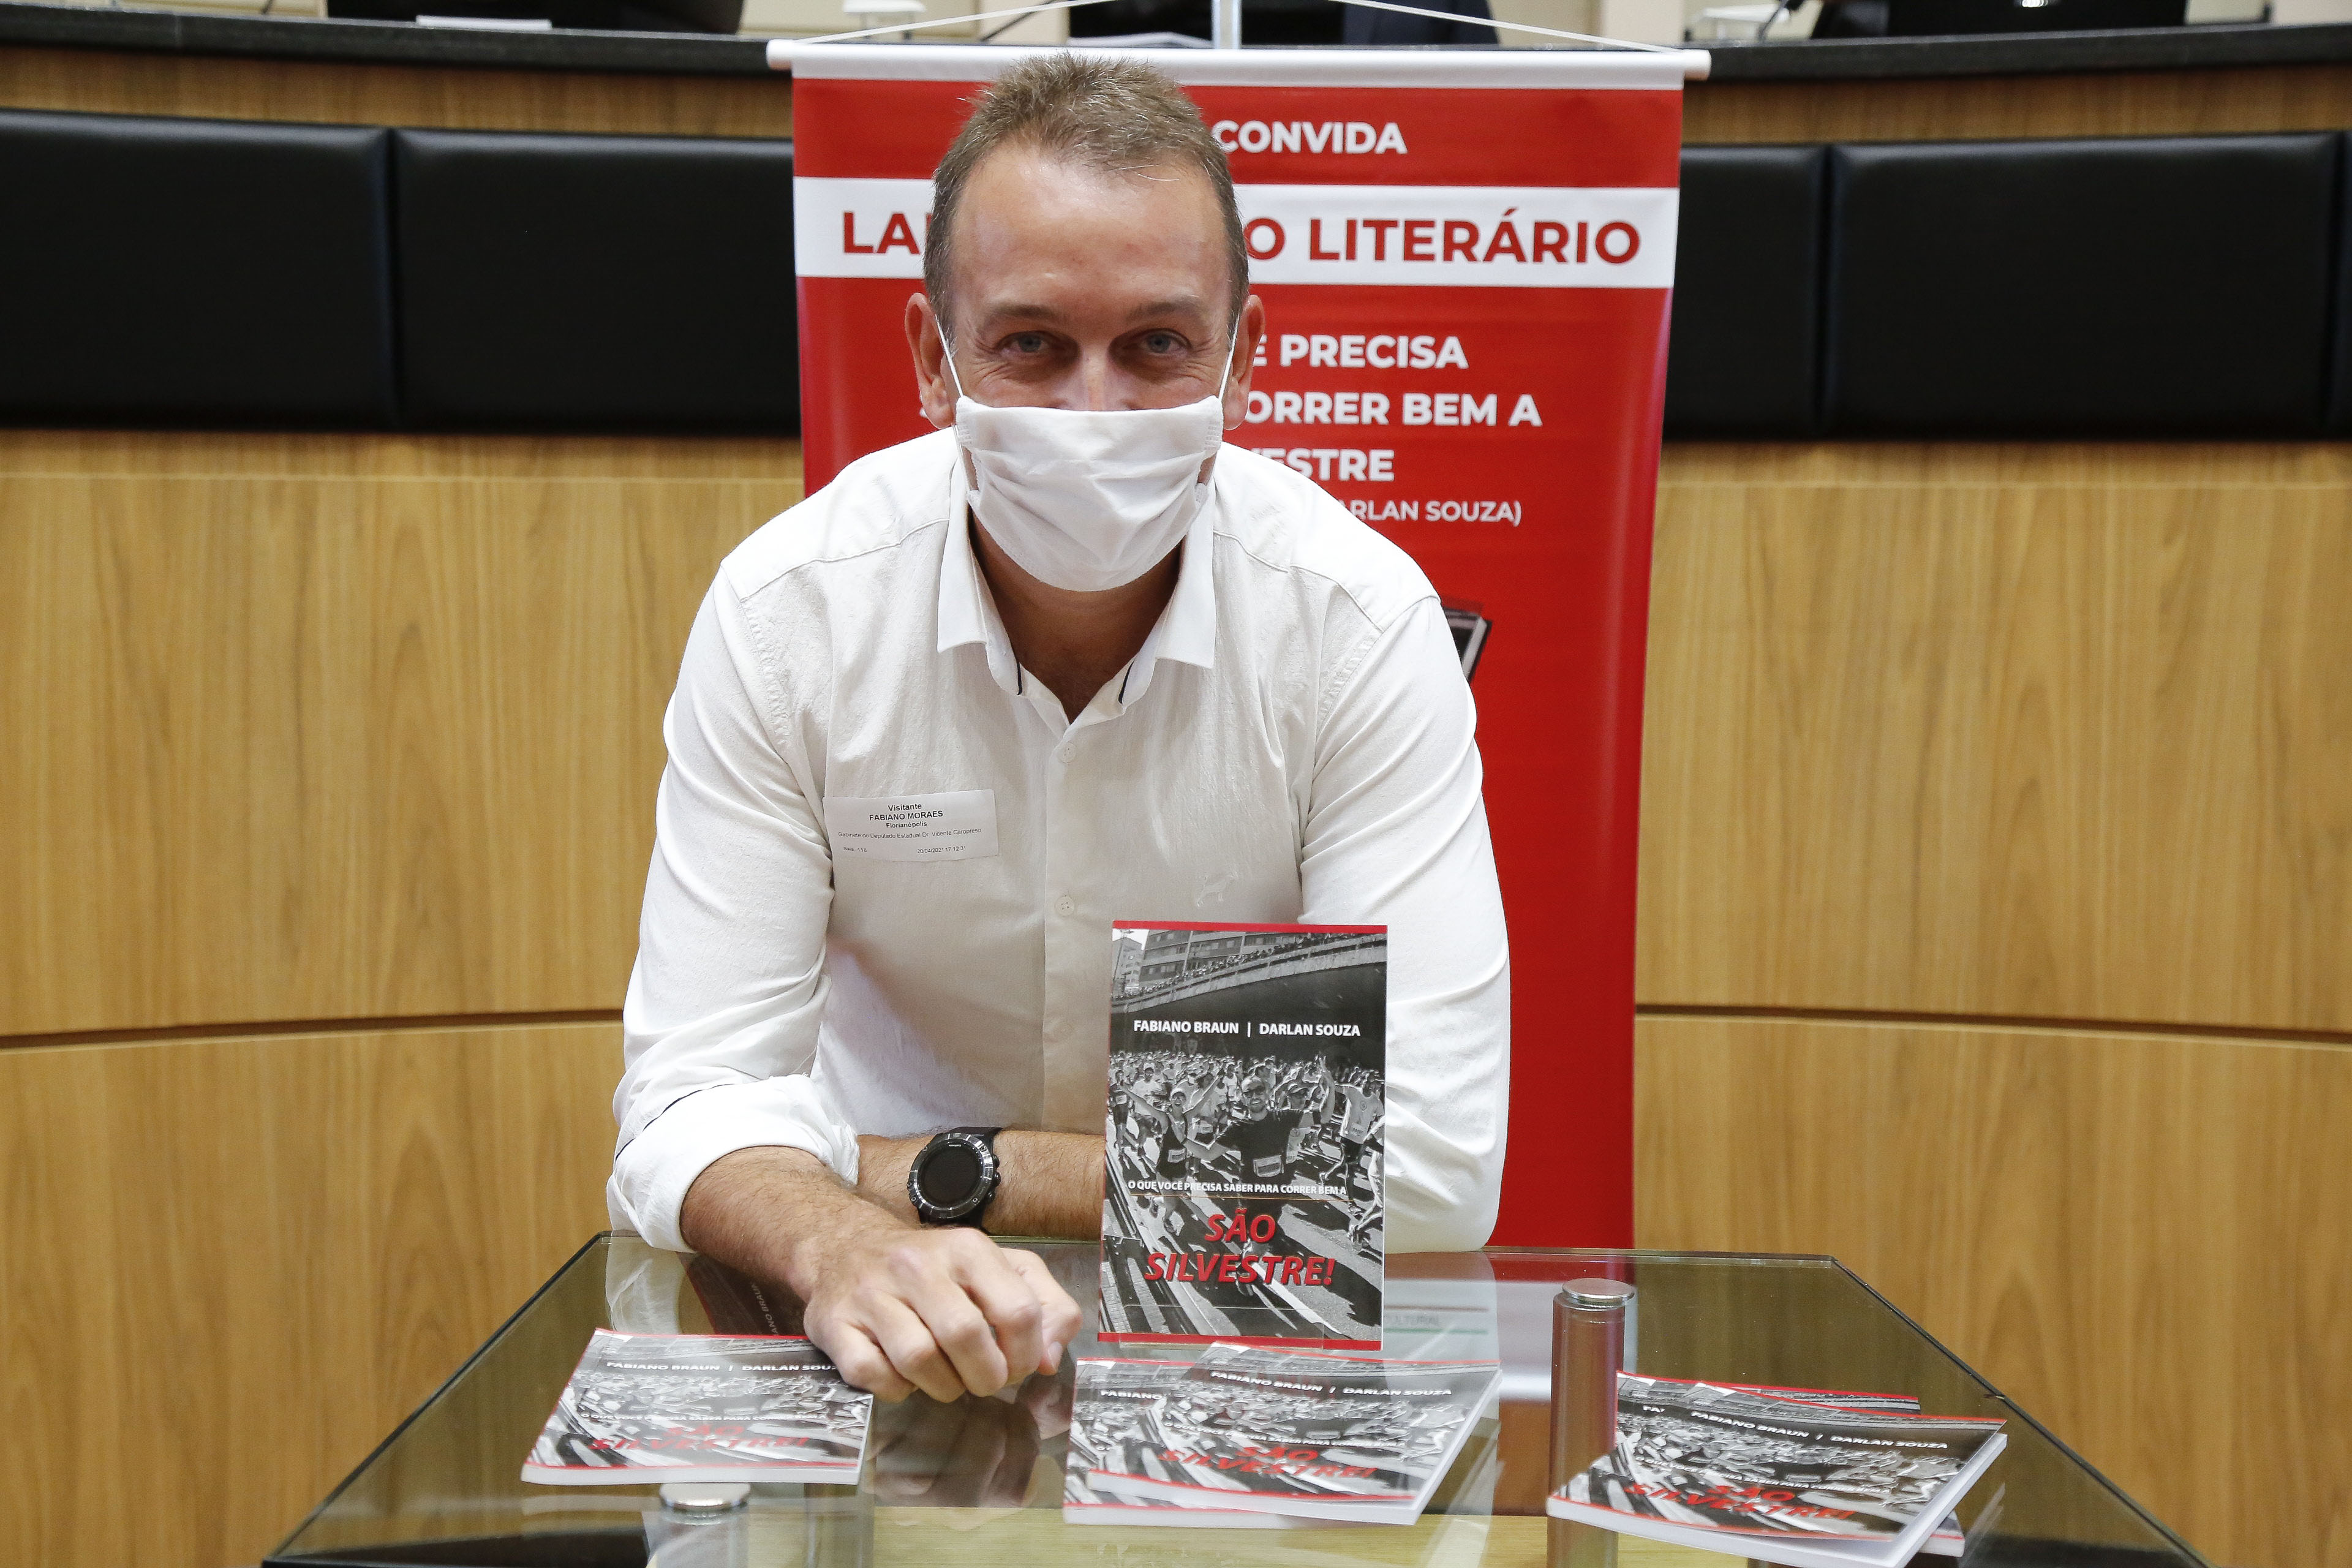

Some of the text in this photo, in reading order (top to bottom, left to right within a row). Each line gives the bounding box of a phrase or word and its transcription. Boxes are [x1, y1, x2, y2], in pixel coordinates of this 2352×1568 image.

[1213, 120, 1408, 154] CONVIDA
[843, 212, 933, 255] LA
[1309, 207, 1640, 264] LITERÁRIO
[1281, 334, 1469, 369] PRECISA
[1245, 391, 1543, 427] ORRER BEM A
[1425, 500, 1522, 527] SOUZA)
[888, 803, 922, 812] Visitante
[908, 810, 943, 819] MORAES
[1134, 1020, 1192, 1033] FABIANO
[1194, 1021, 1239, 1035] BRAUN
[1259, 1023, 1313, 1036] DARLAN
[1315, 1023, 1361, 1037] SOUZA
[1137, 1182, 1156, 1190] QUE
[1184, 1182, 1222, 1192] PRECISA
[1223, 1183, 1253, 1193] SABER
[1254, 1184, 1279, 1193] PARA
[1280, 1185, 1316, 1194] CORRER
[1319, 1186, 1338, 1194] BEM
[1340, 1186, 1347, 1194] A
[1205, 1207, 1276, 1243] SÃO
[1144, 1253, 1336, 1286] SILVESTRE!
[606, 1361, 668, 1370] FABIANO
[1210, 1371, 1272, 1386] FABIANO
[1273, 1381, 1323, 1393] BRAUN
[1343, 1387, 1403, 1396] DARLAN
[1691, 1411, 1757, 1430] FABIANO
[1757, 1425, 1809, 1439] BRAUN
[1830, 1436, 1894, 1447] DARLAN
[1895, 1440, 1948, 1449] SOUZA
